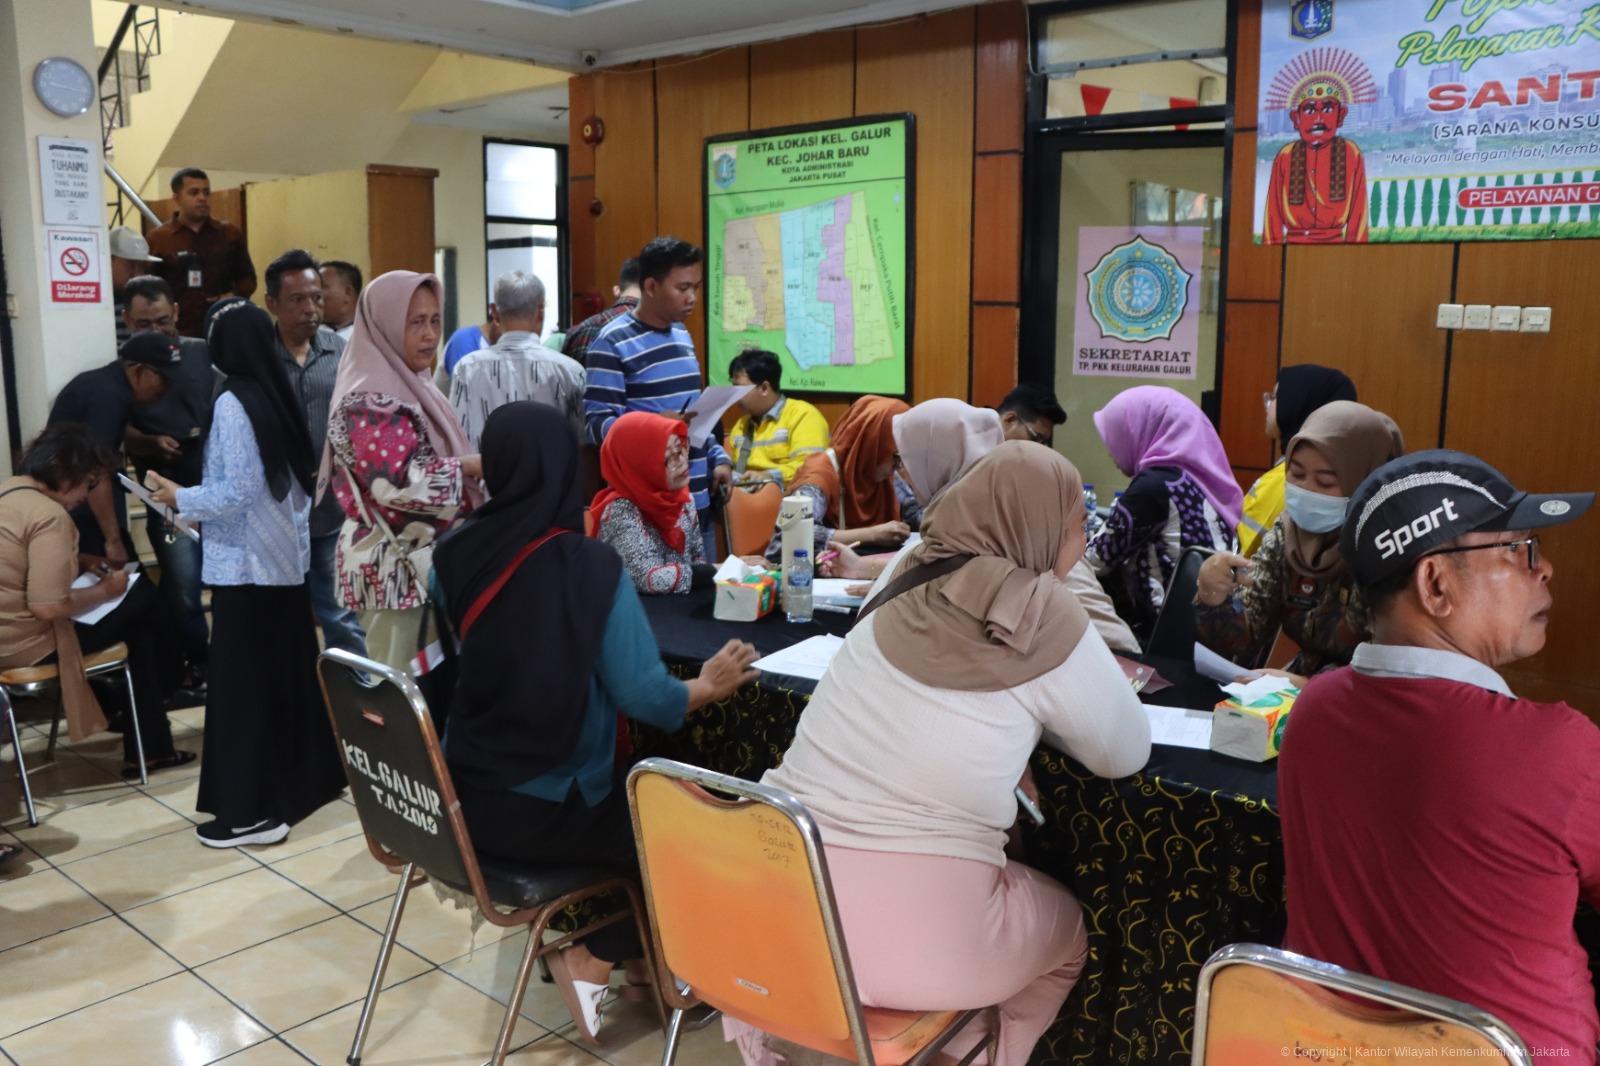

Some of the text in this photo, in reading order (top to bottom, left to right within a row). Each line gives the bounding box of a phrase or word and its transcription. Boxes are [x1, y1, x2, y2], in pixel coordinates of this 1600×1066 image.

[1396, 25, 1564, 71] Pelayanan
[1427, 70, 1600, 112] SANT
[1433, 122, 1520, 140] (SARANA
[747, 127, 891, 154] PETA LOKASI KEL. GALUR
[767, 145, 869, 167] KEC. JOHAR BARU
[1454, 148, 1508, 164] dengan
[1512, 144, 1546, 160] Hati,
[51, 159, 89, 173] TUHANMU
[782, 160, 854, 175] KOTA ADMINISTRASI
[789, 170, 847, 183] JAKARTA PUSAT
[1469, 188, 1581, 206] PELAYANAN
[53, 234, 94, 243] Kawasan
[56, 283, 97, 292] Dilarang
[1079, 347, 1192, 363] SEKRETARIAT
[1079, 361, 1192, 375] TP. PKK KELURAHAN GALUR
[1374, 497, 1459, 560] Sport
